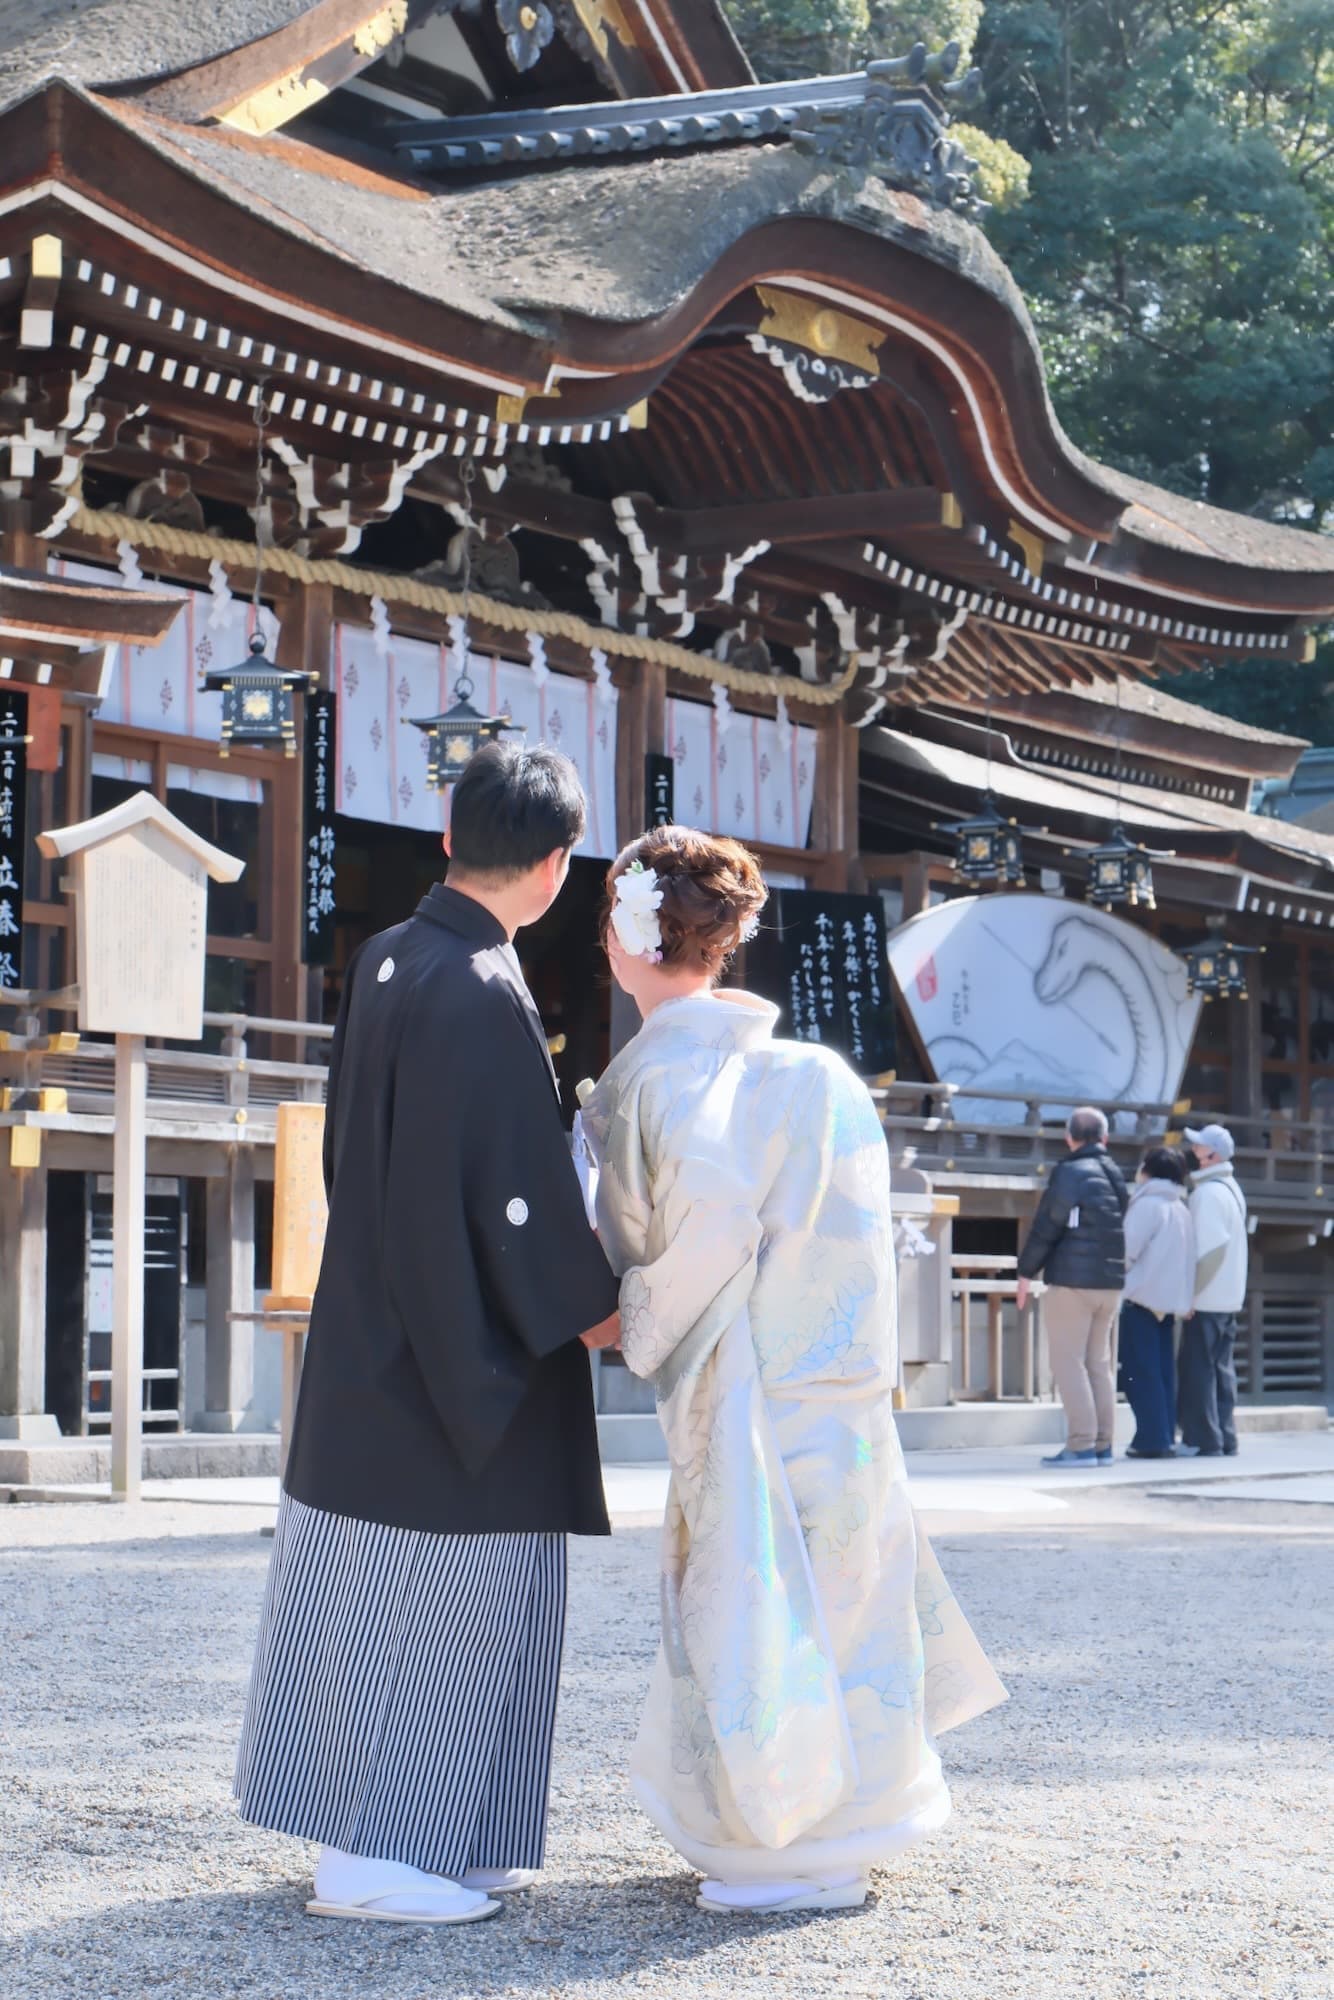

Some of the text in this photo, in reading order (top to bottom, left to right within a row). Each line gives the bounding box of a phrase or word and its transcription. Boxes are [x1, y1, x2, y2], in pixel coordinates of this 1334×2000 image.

[863, 912, 880, 1005] あたらしき
